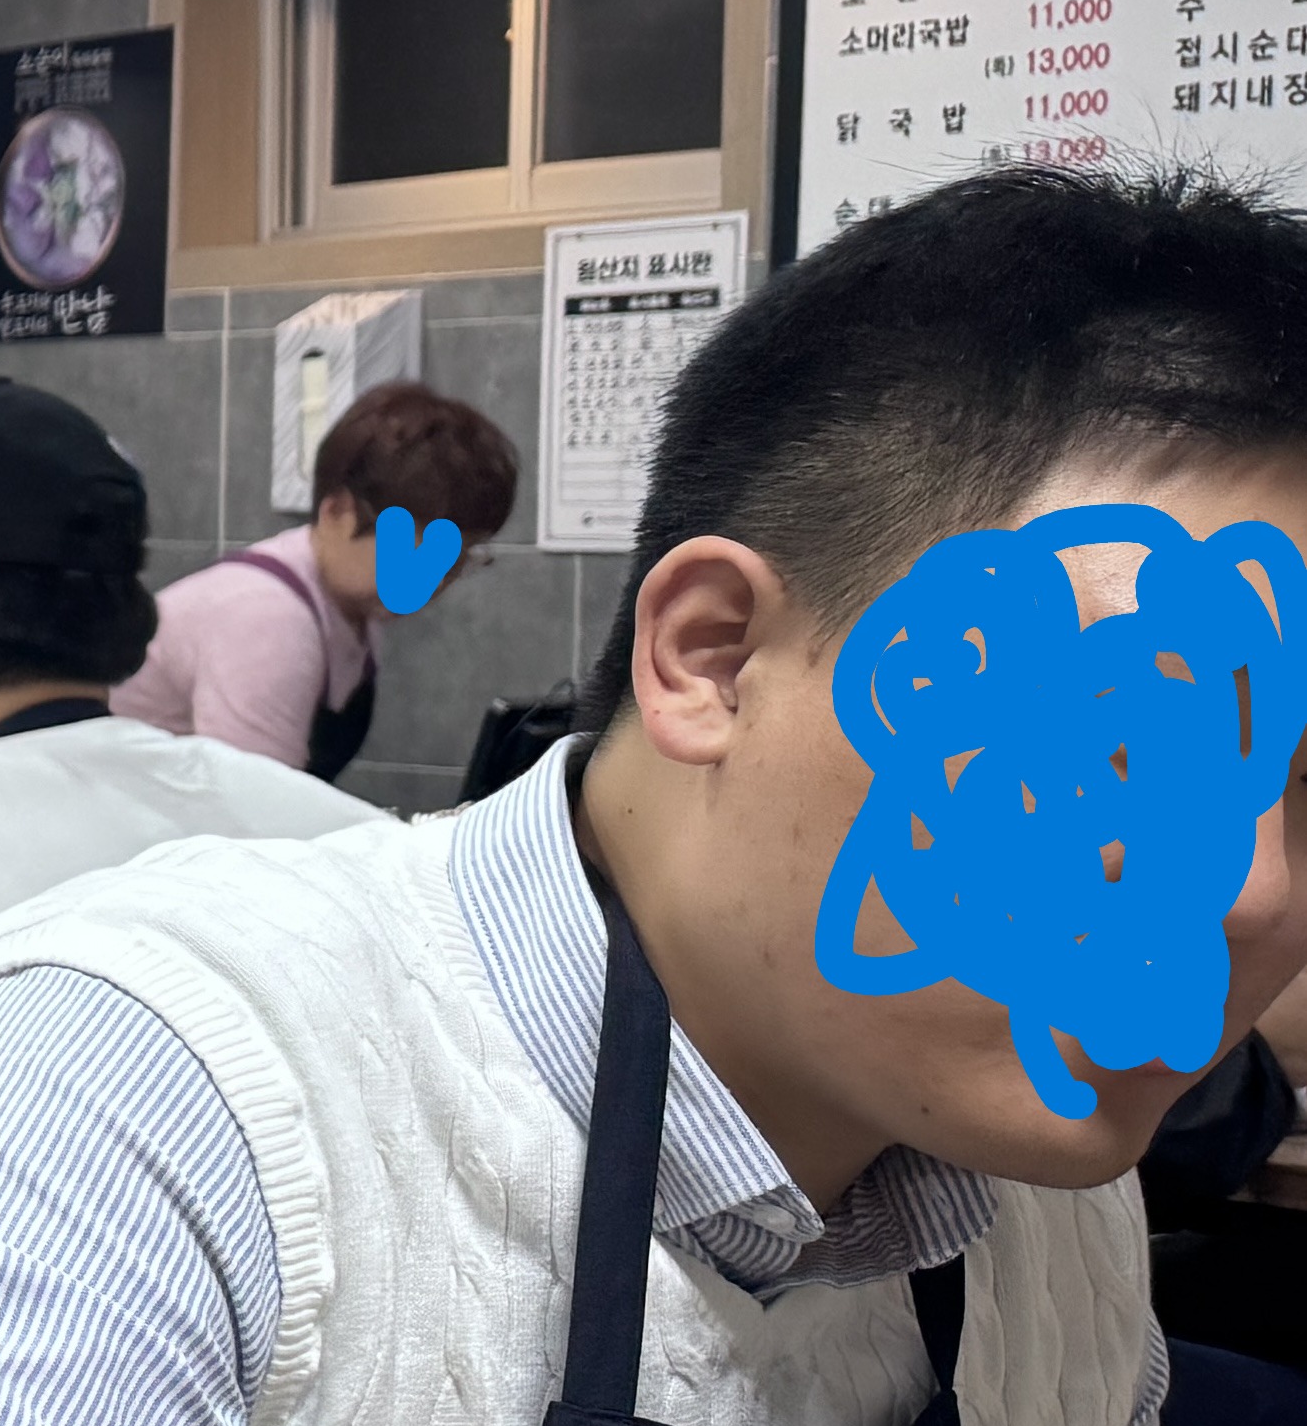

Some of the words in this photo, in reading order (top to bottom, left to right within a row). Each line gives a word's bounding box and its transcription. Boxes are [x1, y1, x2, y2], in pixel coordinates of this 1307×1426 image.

[838, 14, 971, 57] 소머리국밥
[1026, 42, 1111, 77] 13,000
[1024, 88, 1109, 122] 11,000
